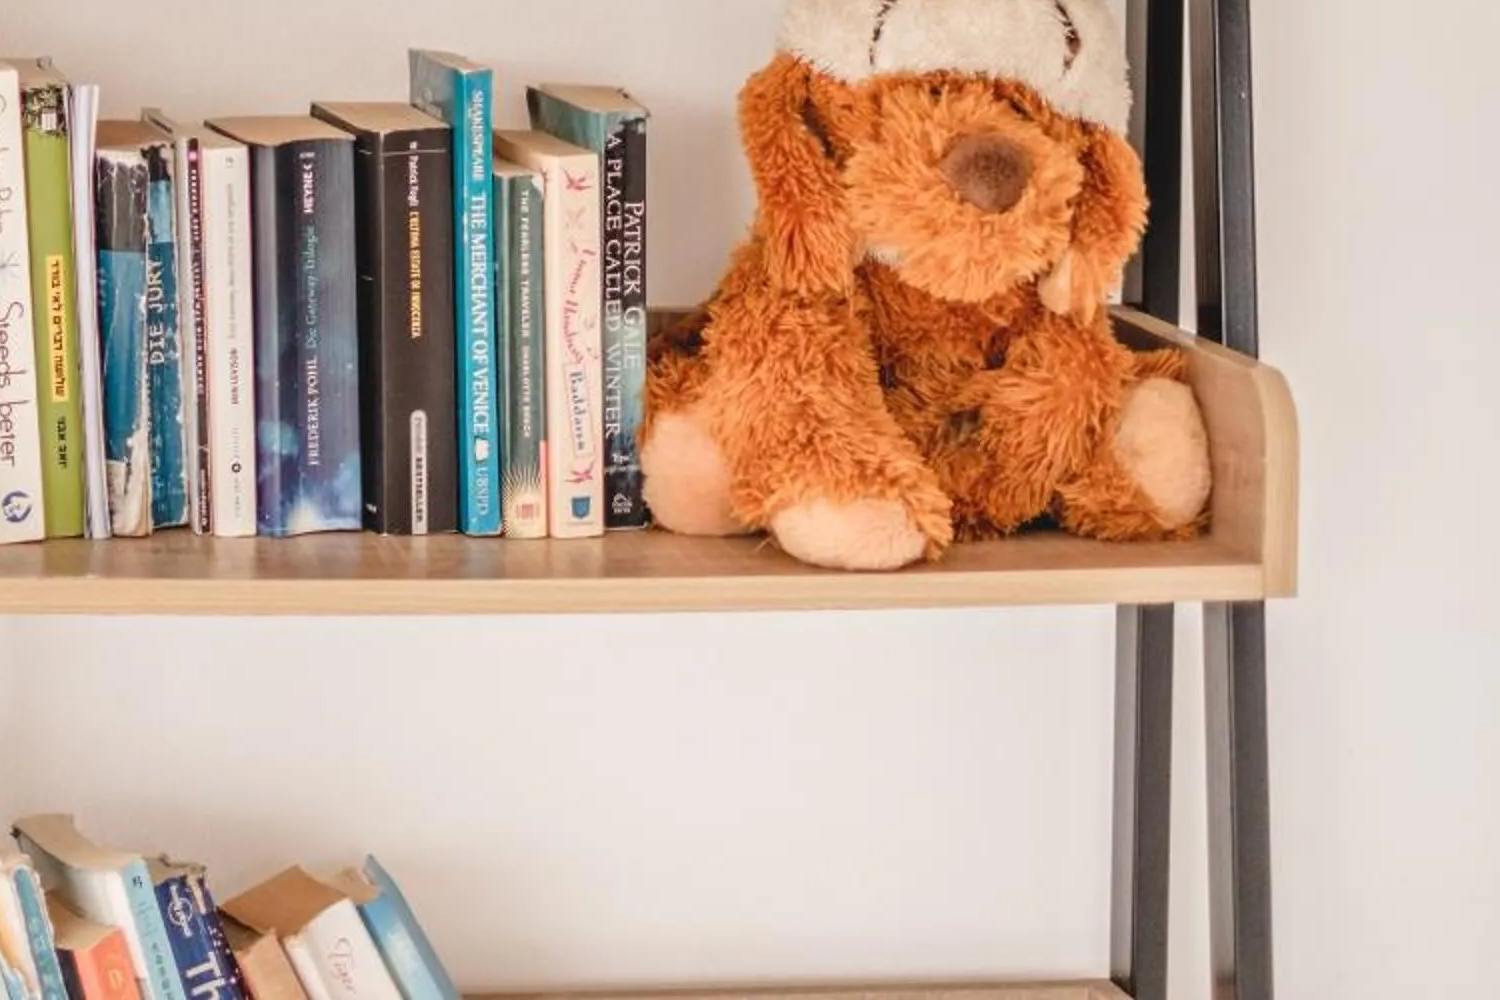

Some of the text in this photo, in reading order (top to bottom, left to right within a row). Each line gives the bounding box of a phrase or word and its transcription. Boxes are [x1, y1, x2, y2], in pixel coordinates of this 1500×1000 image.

[302, 172, 316, 215] HEYNE
[520, 217, 531, 275] FEARLESS
[147, 258, 166, 365] DIE JURY
[471, 190, 489, 435] THE MERCHANT OF VENICE
[521, 280, 531, 338] TRAVELER
[605, 133, 623, 439] A PLACE CALLED WINTER
[623, 199, 645, 370] PATRICK GALE
[305, 355, 319, 466] FREDERIK POHL
